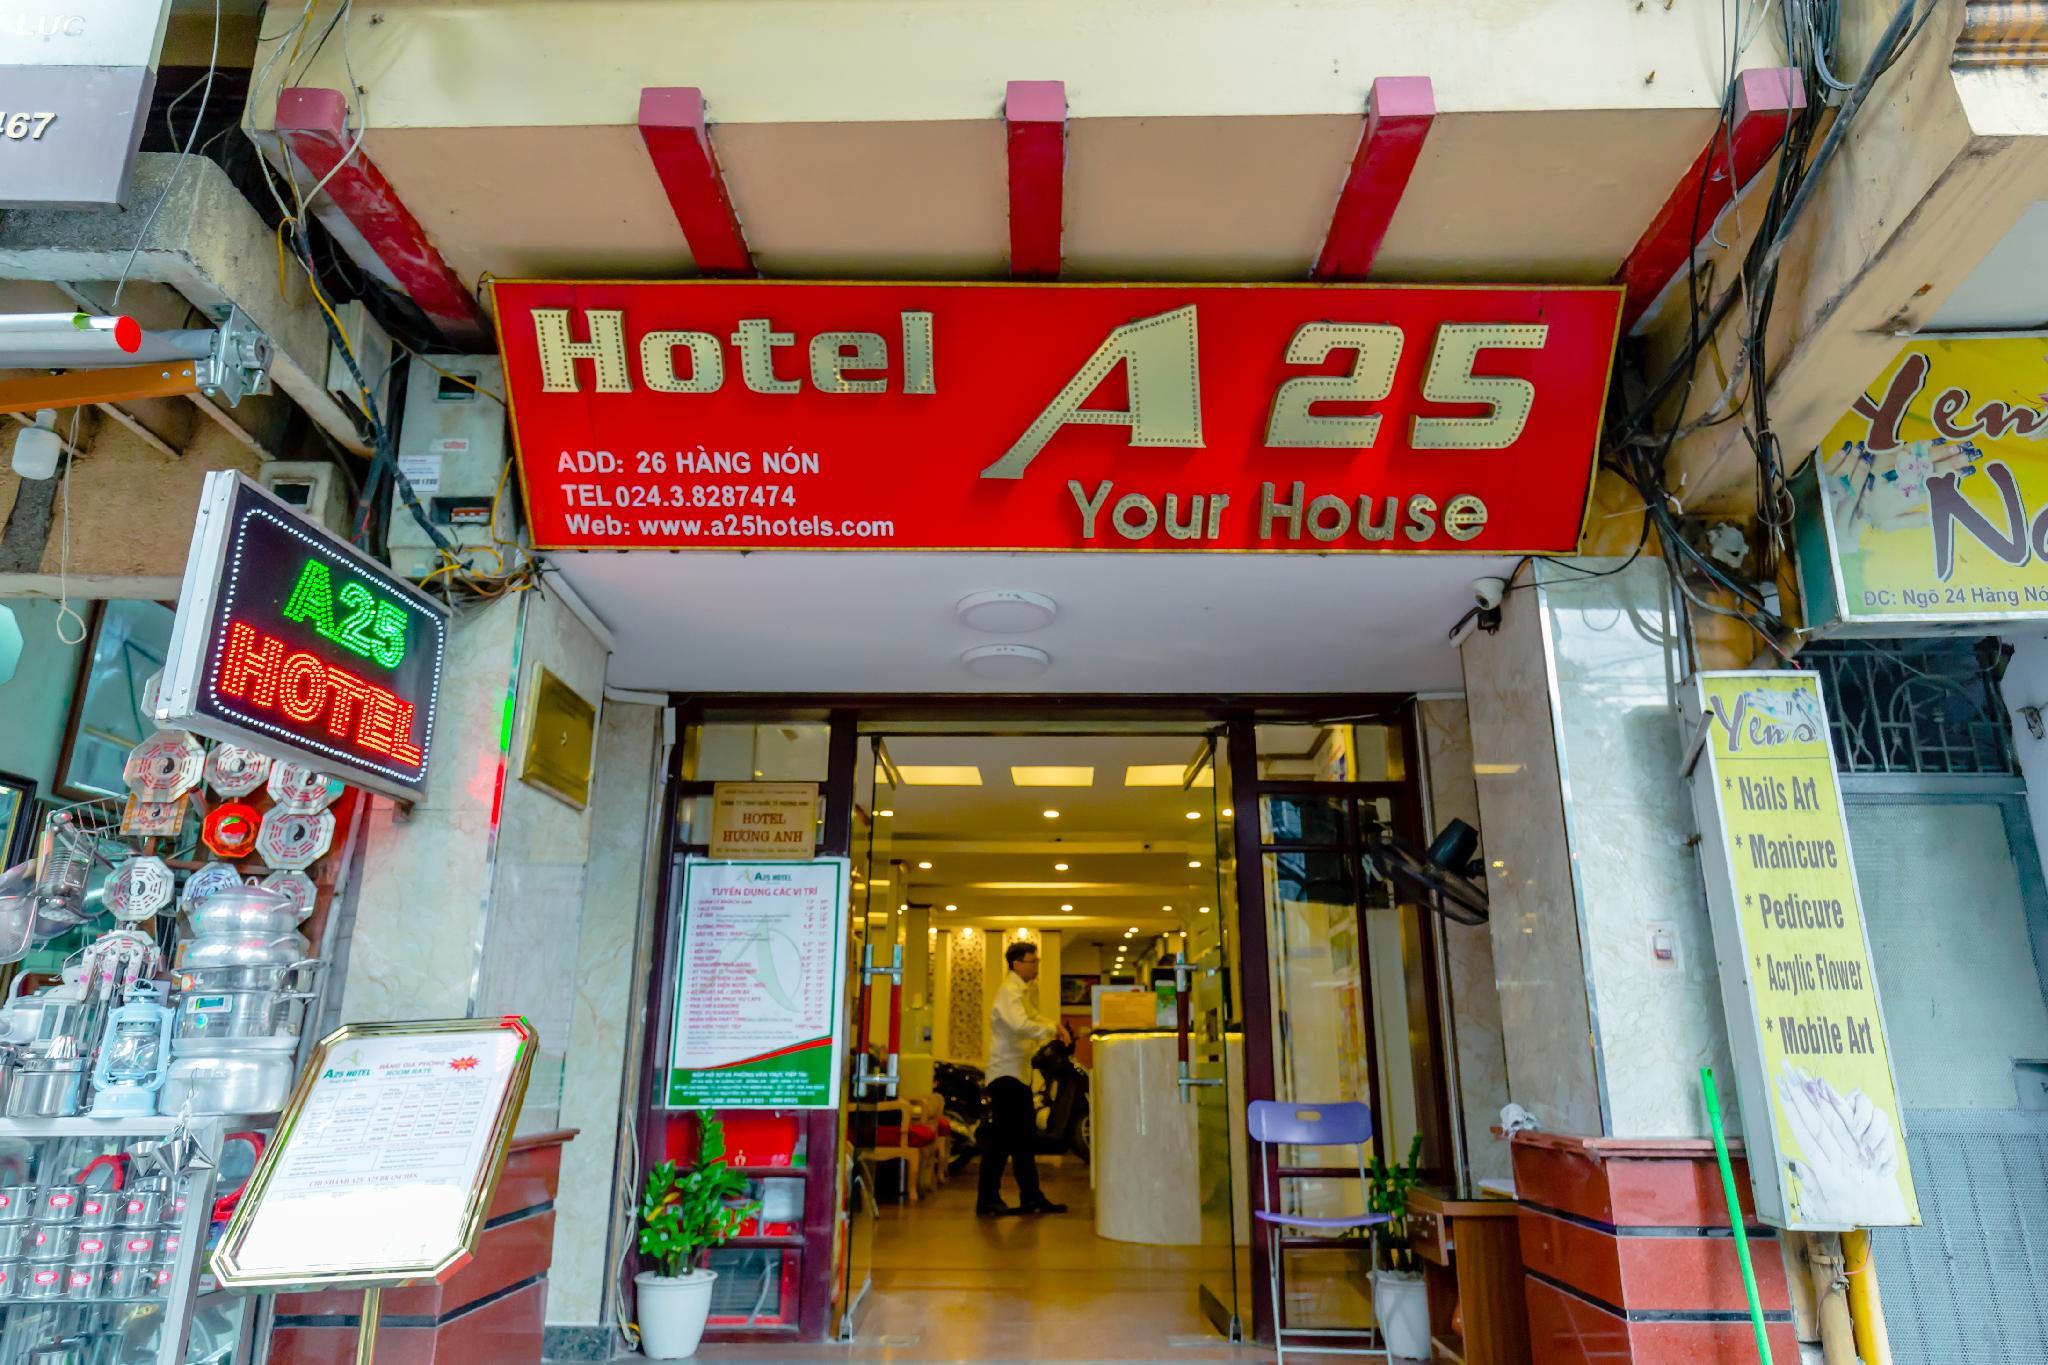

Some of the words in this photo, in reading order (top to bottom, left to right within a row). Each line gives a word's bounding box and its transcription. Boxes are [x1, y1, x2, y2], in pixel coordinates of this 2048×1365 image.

[530, 307, 937, 395] Hotel
[558, 451, 624, 474] ADD:
[636, 452, 667, 474] 26
[676, 445, 751, 475] HÀNG
[762, 446, 820, 475] NÓN
[565, 514, 631, 536] Web:
[638, 514, 895, 537] www.a25hotels.com
[1067, 479, 1230, 540] Your
[1260, 480, 1489, 542] House
[1945, 588, 1967, 603] 24
[1971, 586, 2020, 607] Hàng
[283, 559, 408, 670] A25
[221, 622, 423, 767] HOTEL
[1738, 776, 1788, 810] Nails
[1792, 776, 1820, 810] Art
[743, 812, 786, 825] HOTEL
[774, 830, 803, 843] ANH
[1749, 834, 1838, 868] Manicure
[1758, 893, 1845, 929] Pedicure
[1767, 954, 1815, 997] Acrylic
[1816, 954, 1864, 991] Flower
[1778, 1016, 1844, 1055] Mobile
[1849, 1016, 1875, 1055] Art
